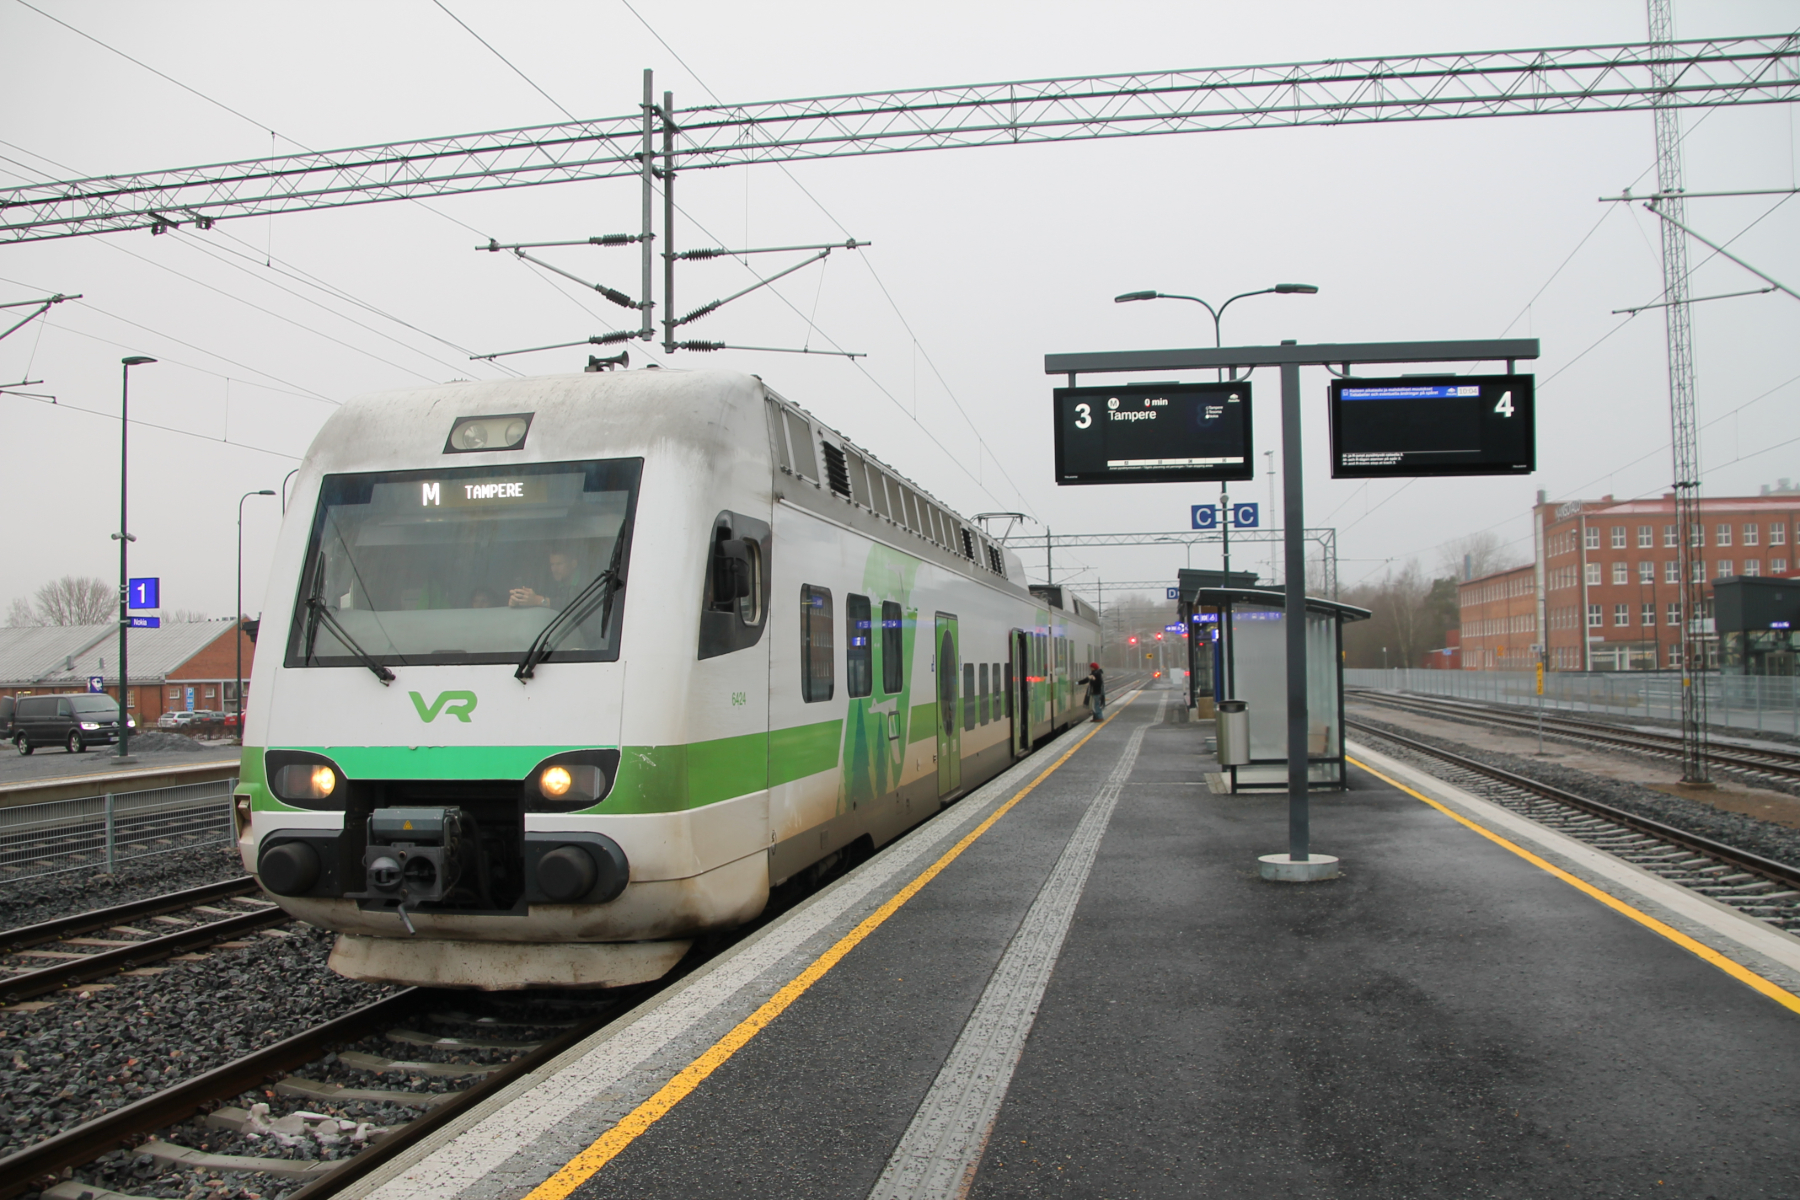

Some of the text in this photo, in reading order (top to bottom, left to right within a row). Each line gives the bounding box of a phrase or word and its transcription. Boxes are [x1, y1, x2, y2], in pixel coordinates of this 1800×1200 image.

[1458, 387, 1478, 395] 10:04
[1144, 398, 1151, 407] 0
[1151, 397, 1168, 406] min
[1494, 390, 1514, 418] 4
[1074, 403, 1092, 429] 3
[1107, 409, 1157, 422] Tampere
[422, 482, 524, 506] M TAMPERE
[1196, 507, 1212, 526] C
[1238, 506, 1254, 524] C
[137, 582, 146, 604] 1
[1168, 589, 1176, 598] D
[133, 618, 148, 626] Nokia
[408, 690, 478, 723] VR
[731, 691, 747, 707] 6424
